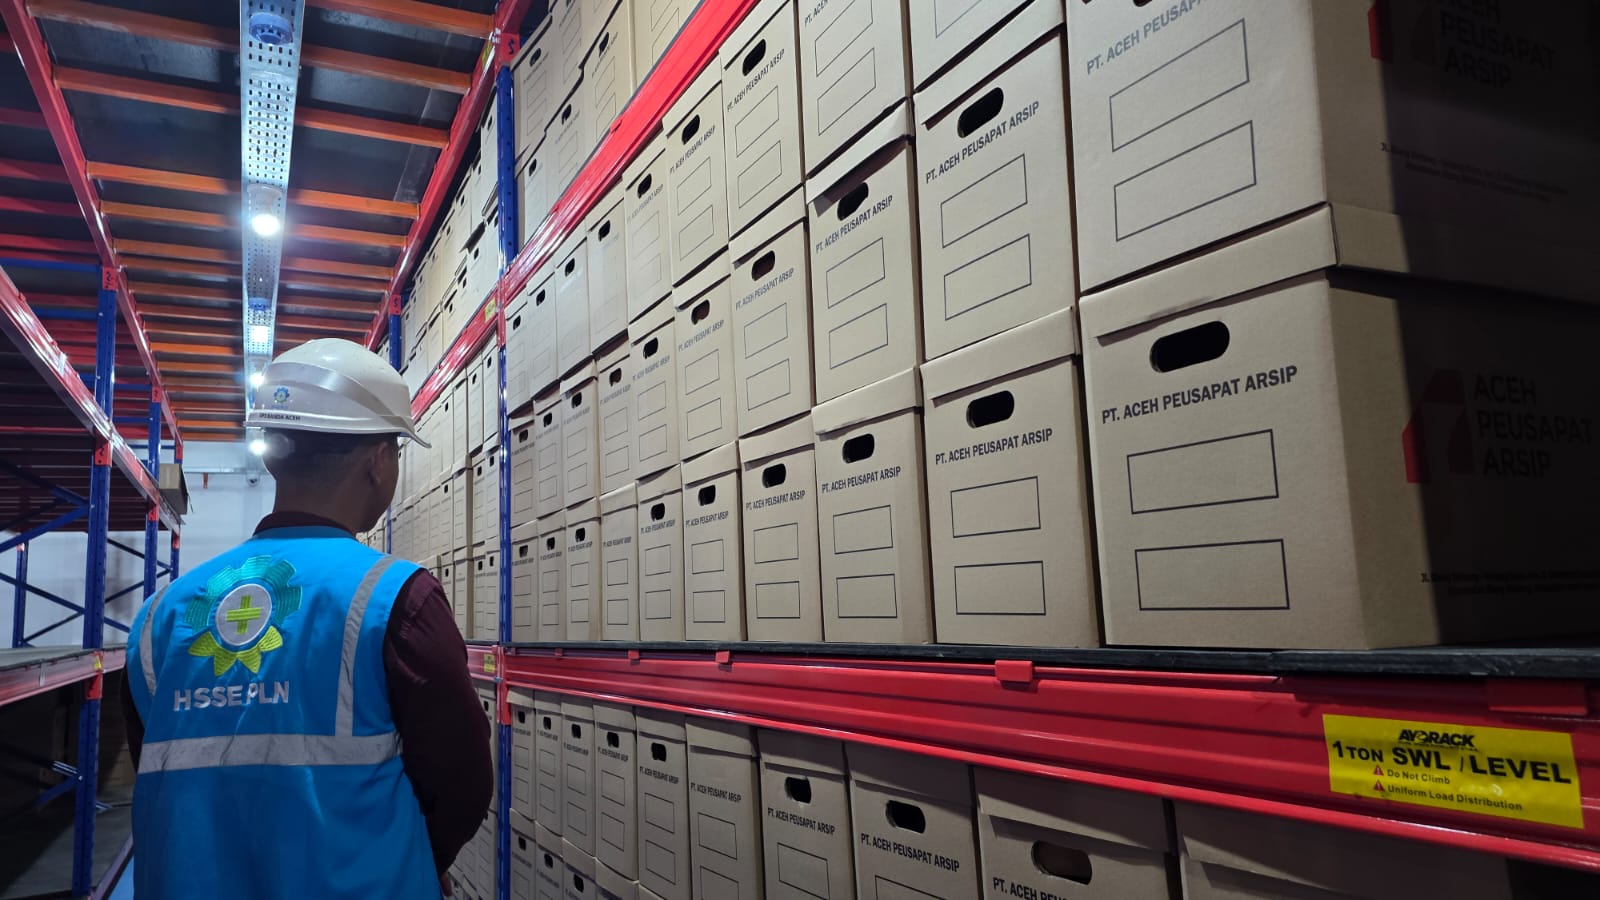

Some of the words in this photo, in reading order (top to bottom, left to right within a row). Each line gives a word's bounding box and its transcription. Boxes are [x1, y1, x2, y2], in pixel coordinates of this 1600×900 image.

[1086, 56, 1104, 75] PT.
[1107, 30, 1140, 63] ACEH
[1440, 9, 1555, 71] PEUSAPAT
[1444, 48, 1512, 88] ARSIP
[926, 170, 937, 183] PT.
[939, 154, 960, 177] ACEH
[962, 121, 1007, 160] PEUSAPAT
[1009, 101, 1039, 131] ARSIP
[825, 231, 839, 248] ACEH
[840, 209, 871, 237] PEUSAPAT
[872, 195, 893, 216] ARSIP
[1102, 408, 1120, 424] PT.
[1123, 398, 1159, 419] ACEH
[1163, 378, 1240, 410] PEUSAPAT
[1244, 365, 1298, 392] ARSIP
[1474, 373, 1537, 406] ACEH
[1476, 409, 1592, 446] PEUSAPAT
[935, 453, 947, 465] PT.
[948, 447, 971, 463] ACEH
[972, 435, 1019, 457] PEUSAPAT
[1021, 428, 1053, 447] ARSIP
[1483, 448, 1552, 479] ARSIP
[822, 484, 830, 494] PT.
[830, 480, 846, 491] ACEH
[847, 471, 879, 488] PEUSAPAT
[879, 466, 901, 480] ARSIP
[173, 685, 243, 712] HSSE
[246, 681, 289, 705] PLN
[1332, 741, 1344, 758] 1
[1345, 746, 1384, 763] TON
[1392, 747, 1451, 770] SWL
[1387, 769, 1399, 779] Do
[1402, 770, 1419, 781] Not
[1422, 773, 1450, 785] Climb
[1387, 785, 1427, 798] Uniform
[1429, 789, 1454, 802] Load
[1456, 793, 1522, 811] Distribution
[776, 810, 789, 822] ACEH
[789, 813, 817, 831] PEUSAPAT
[817, 823, 835, 835] ARSIP
[861, 833, 871, 846] PT.
[872, 836, 892, 852] ACEH
[893, 842, 933, 865] PEUSAPAT
[934, 854, 960, 872] ARSIP
[993, 877, 1008, 893] PT.
[1010, 882, 1037, 900] ACEH
